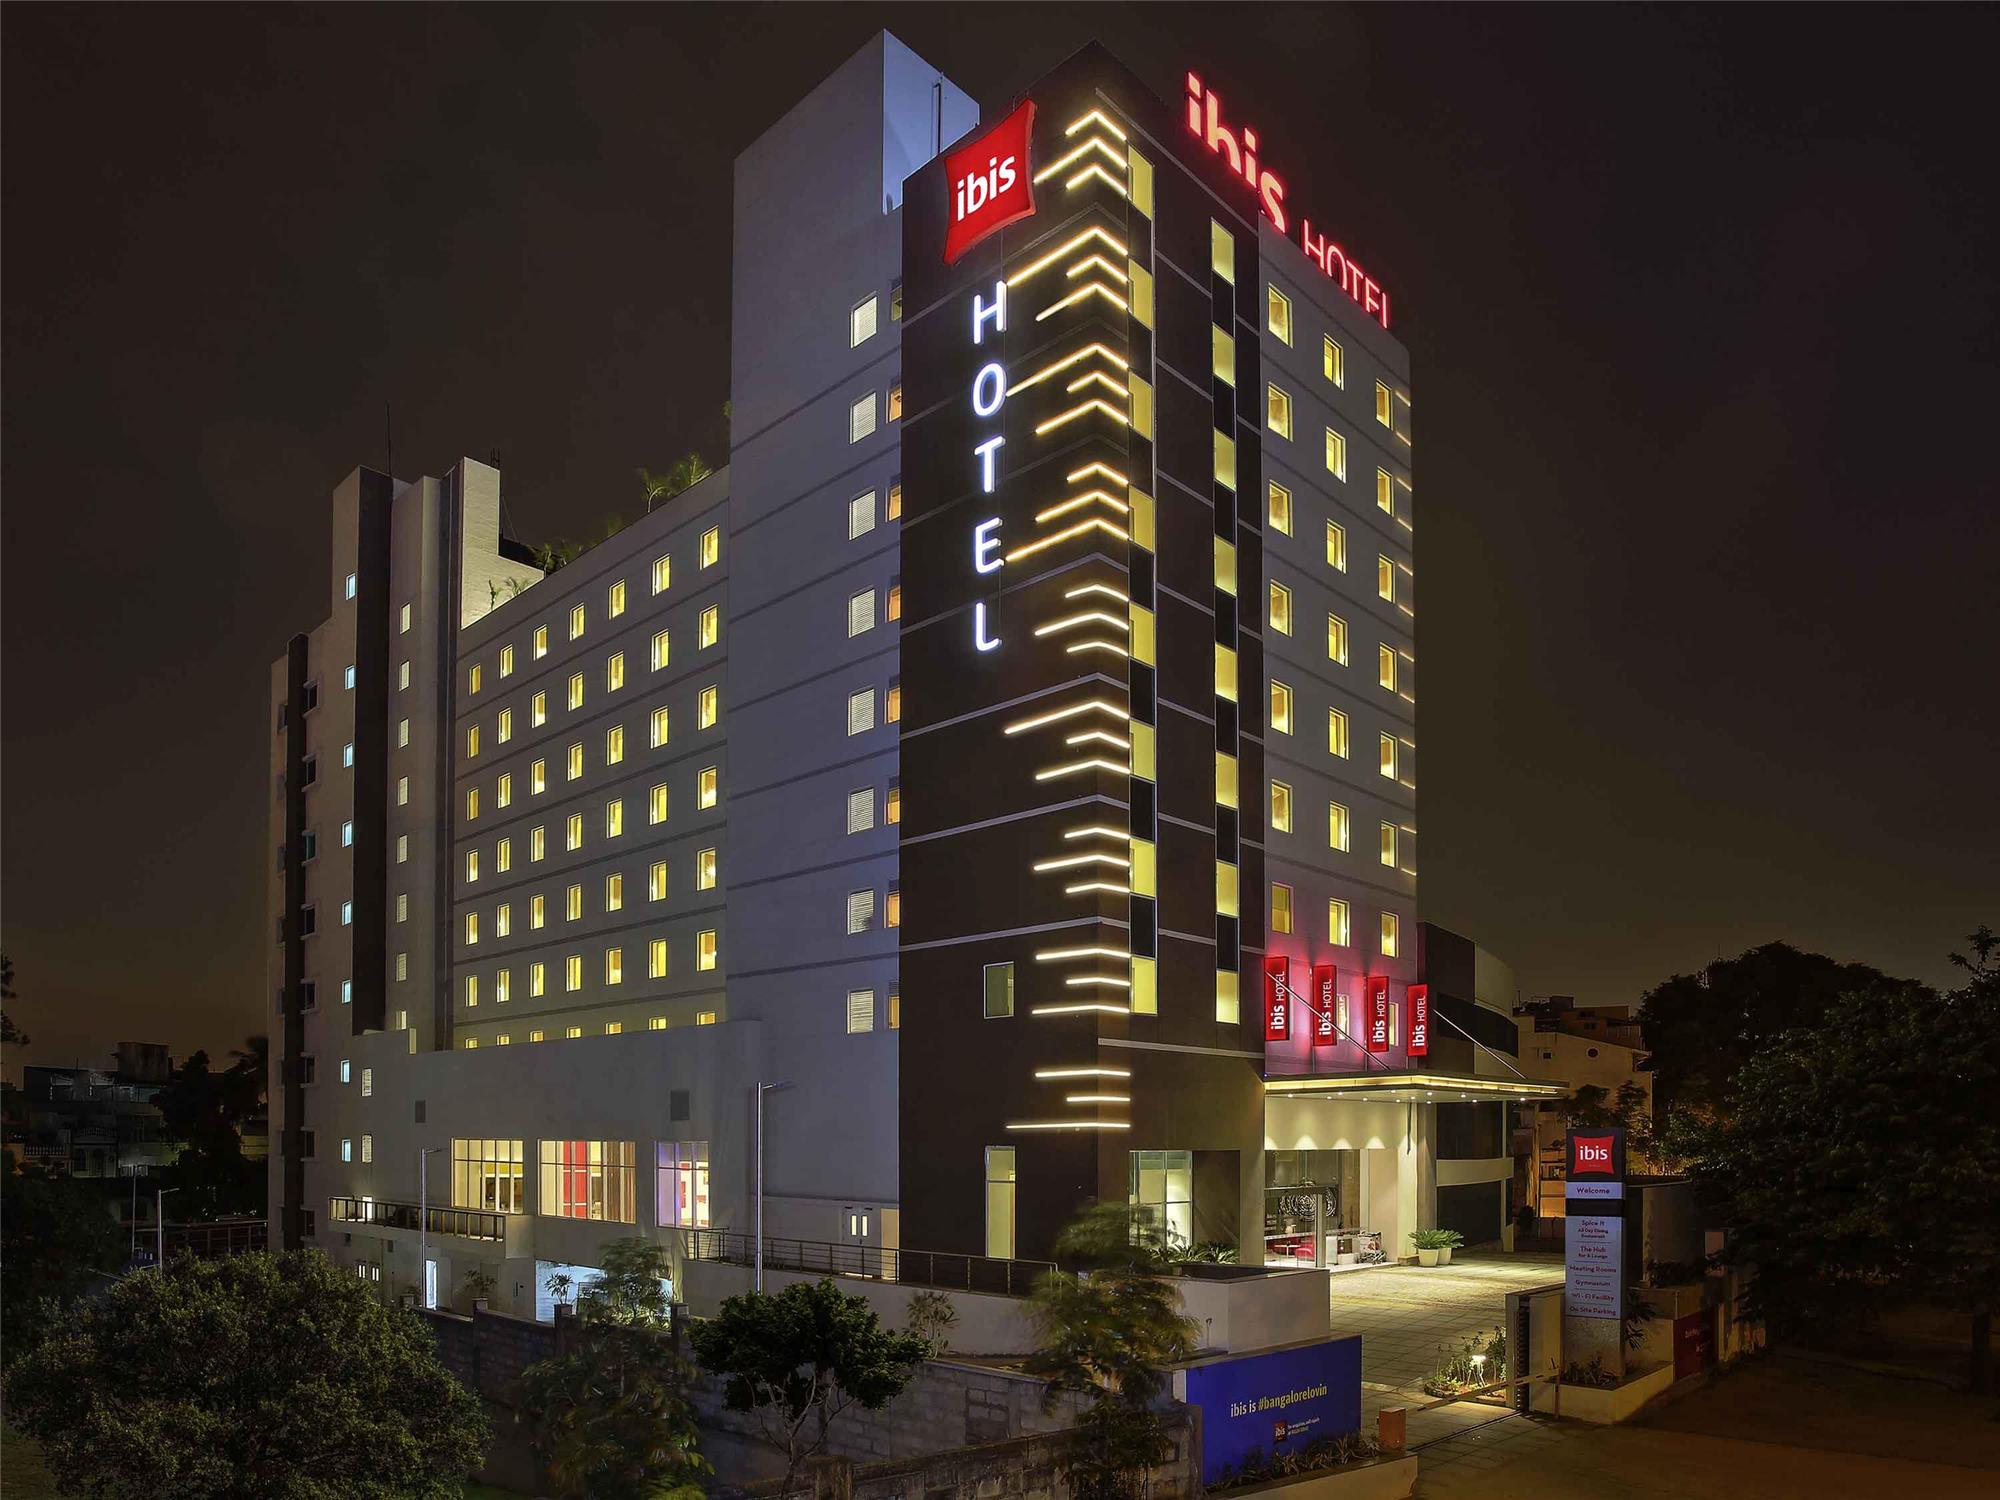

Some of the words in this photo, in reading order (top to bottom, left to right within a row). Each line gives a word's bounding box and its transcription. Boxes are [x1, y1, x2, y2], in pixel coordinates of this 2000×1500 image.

[956, 153, 1017, 221] ibis
[972, 280, 1007, 653] HOTEL
[1275, 971, 1285, 1002] HOTEL
[1323, 979, 1332, 1008] HOTEL
[1377, 989, 1385, 1017] HOTEL
[1417, 995, 1425, 1022] HOTEL
[1270, 1004, 1285, 1030] ibis
[1319, 1011, 1332, 1036] ibis
[1373, 1020, 1385, 1043] ibis
[1412, 1024, 1425, 1047] ibis
[1579, 1145, 1608, 1161] ibis
[1576, 1186, 1610, 1195] Welcome
[1230, 1401, 1247, 1418] ibis
[1249, 1399, 1257, 1413] is
[1258, 1384, 1328, 1410] #bangalorelovin
